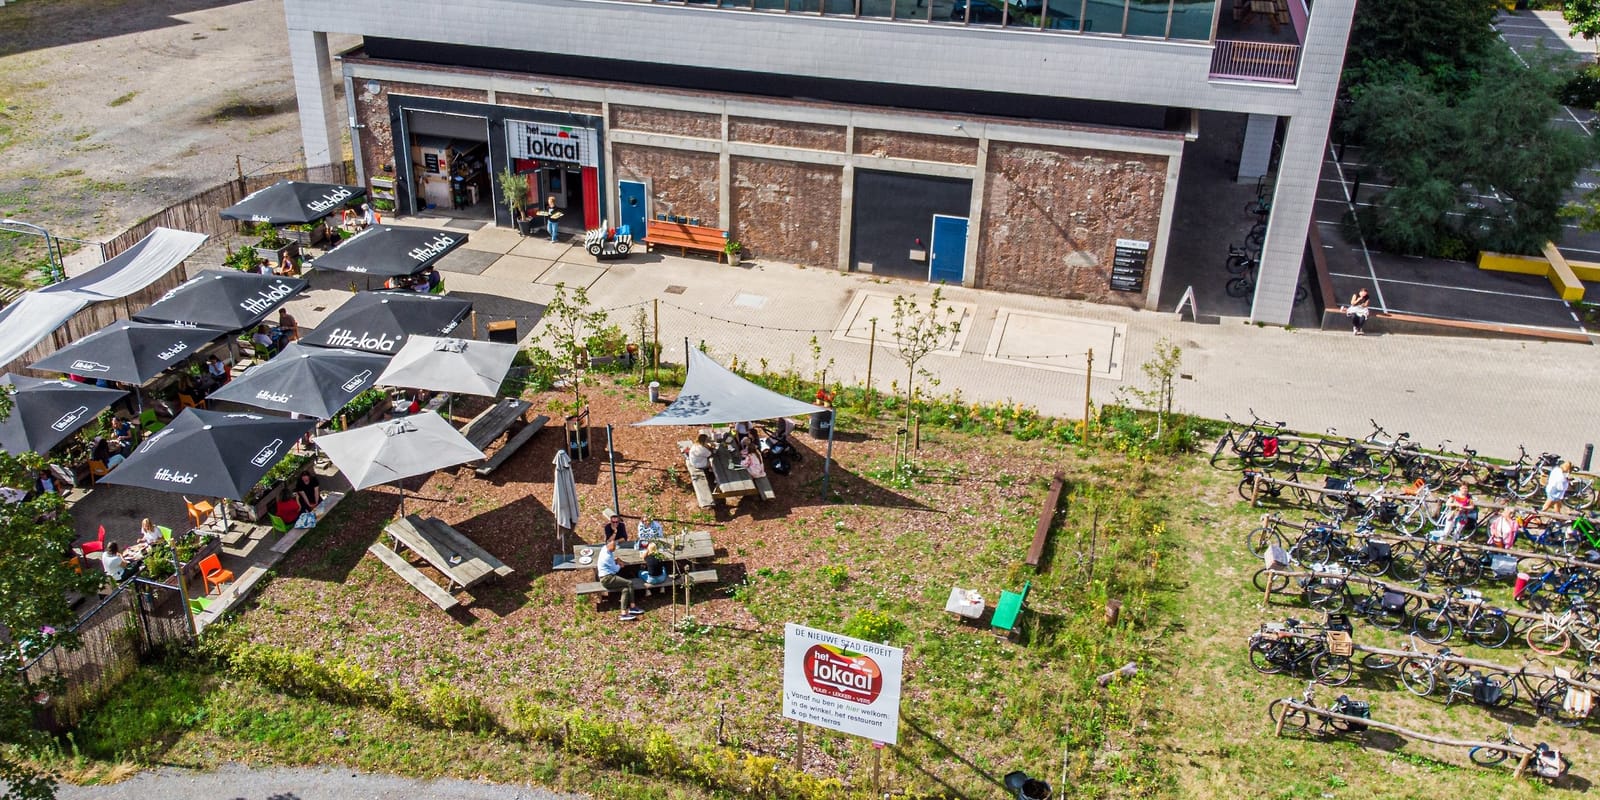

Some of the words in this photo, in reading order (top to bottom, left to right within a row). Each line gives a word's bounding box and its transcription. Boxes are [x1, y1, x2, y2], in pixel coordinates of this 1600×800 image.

[526, 124, 540, 135] het
[526, 136, 580, 160] lokaal
[240, 284, 294, 315] fritz-kola
[326, 328, 394, 351] fritz-kola
[796, 628, 806, 636] DE
[808, 632, 838, 644] NIEUWE
[840, 639, 861, 651] STAD
[863, 645, 892, 658] GROEIT
[814, 650, 830, 662] het
[814, 660, 873, 690] lokaal
[791, 691, 810, 700] Vanaf
[822, 717, 840, 726] terras
[834, 711, 846, 719] het
[848, 714, 883, 726] restaurant
